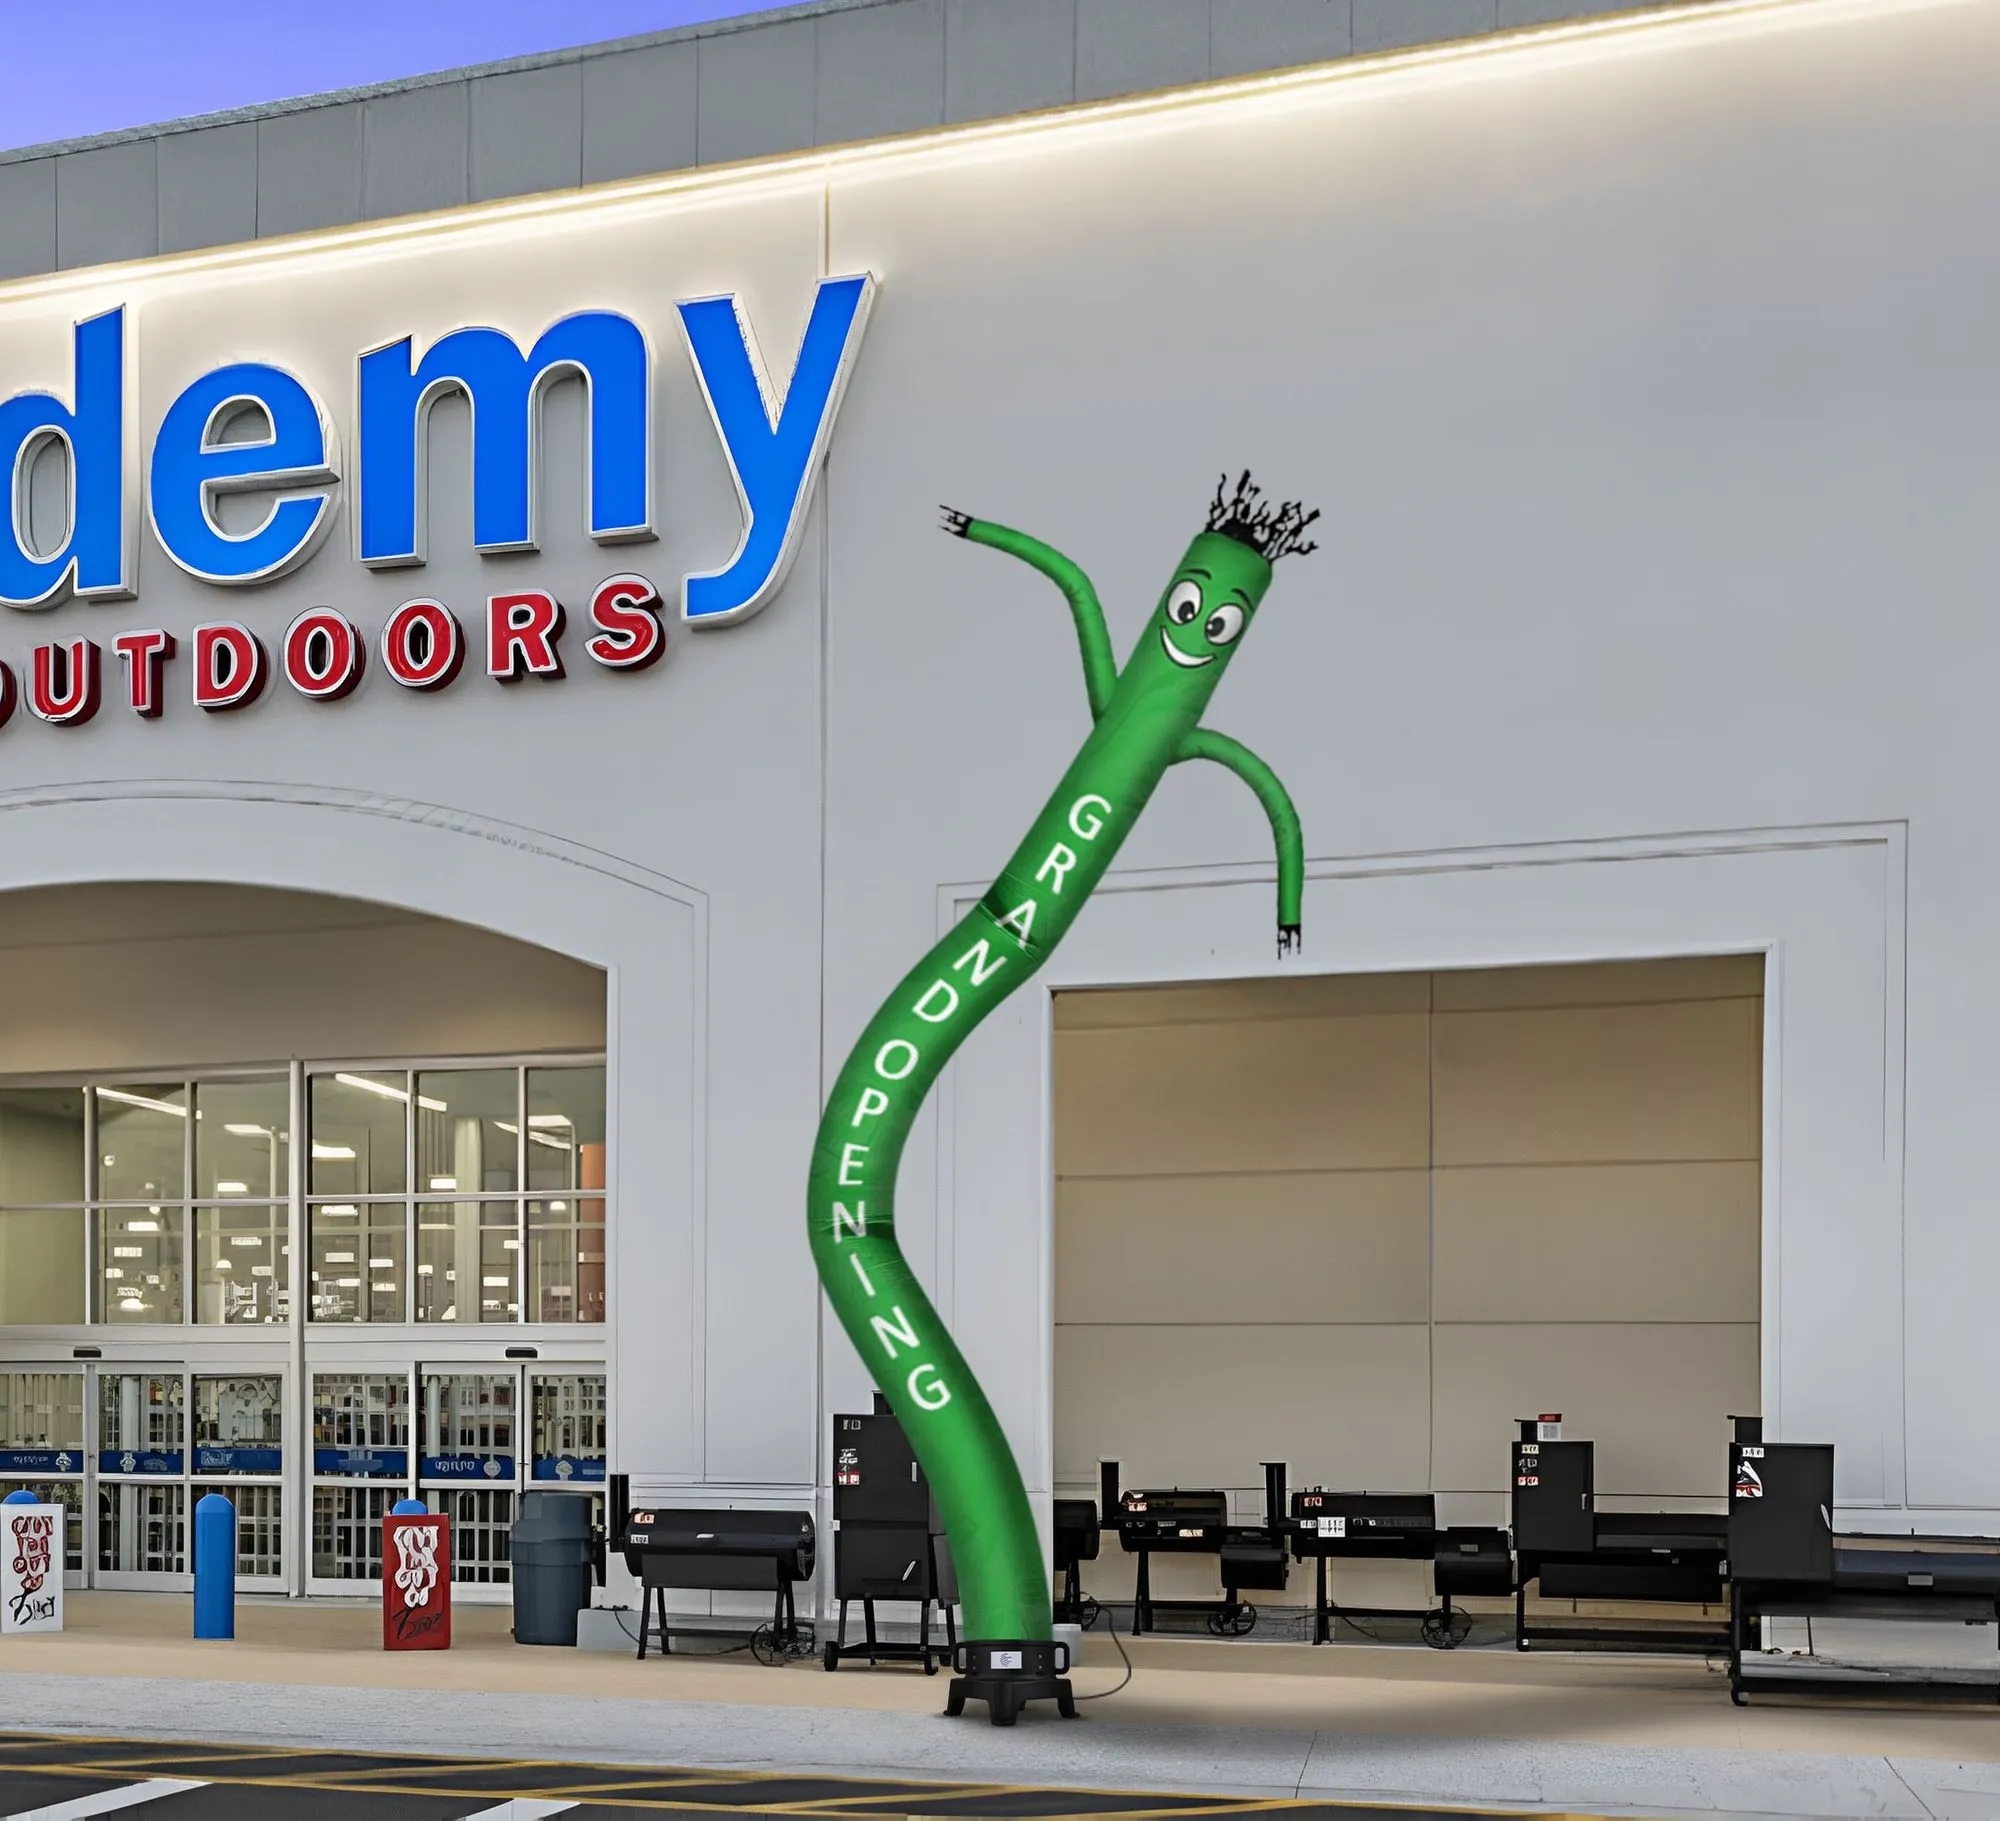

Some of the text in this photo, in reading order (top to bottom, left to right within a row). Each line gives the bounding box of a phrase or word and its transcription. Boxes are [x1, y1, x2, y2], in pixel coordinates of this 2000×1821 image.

[0, 271, 878, 629] demy
[0, 573, 664, 730] UTDOORS
[832, 793, 1112, 1413] GRAND OPENING
